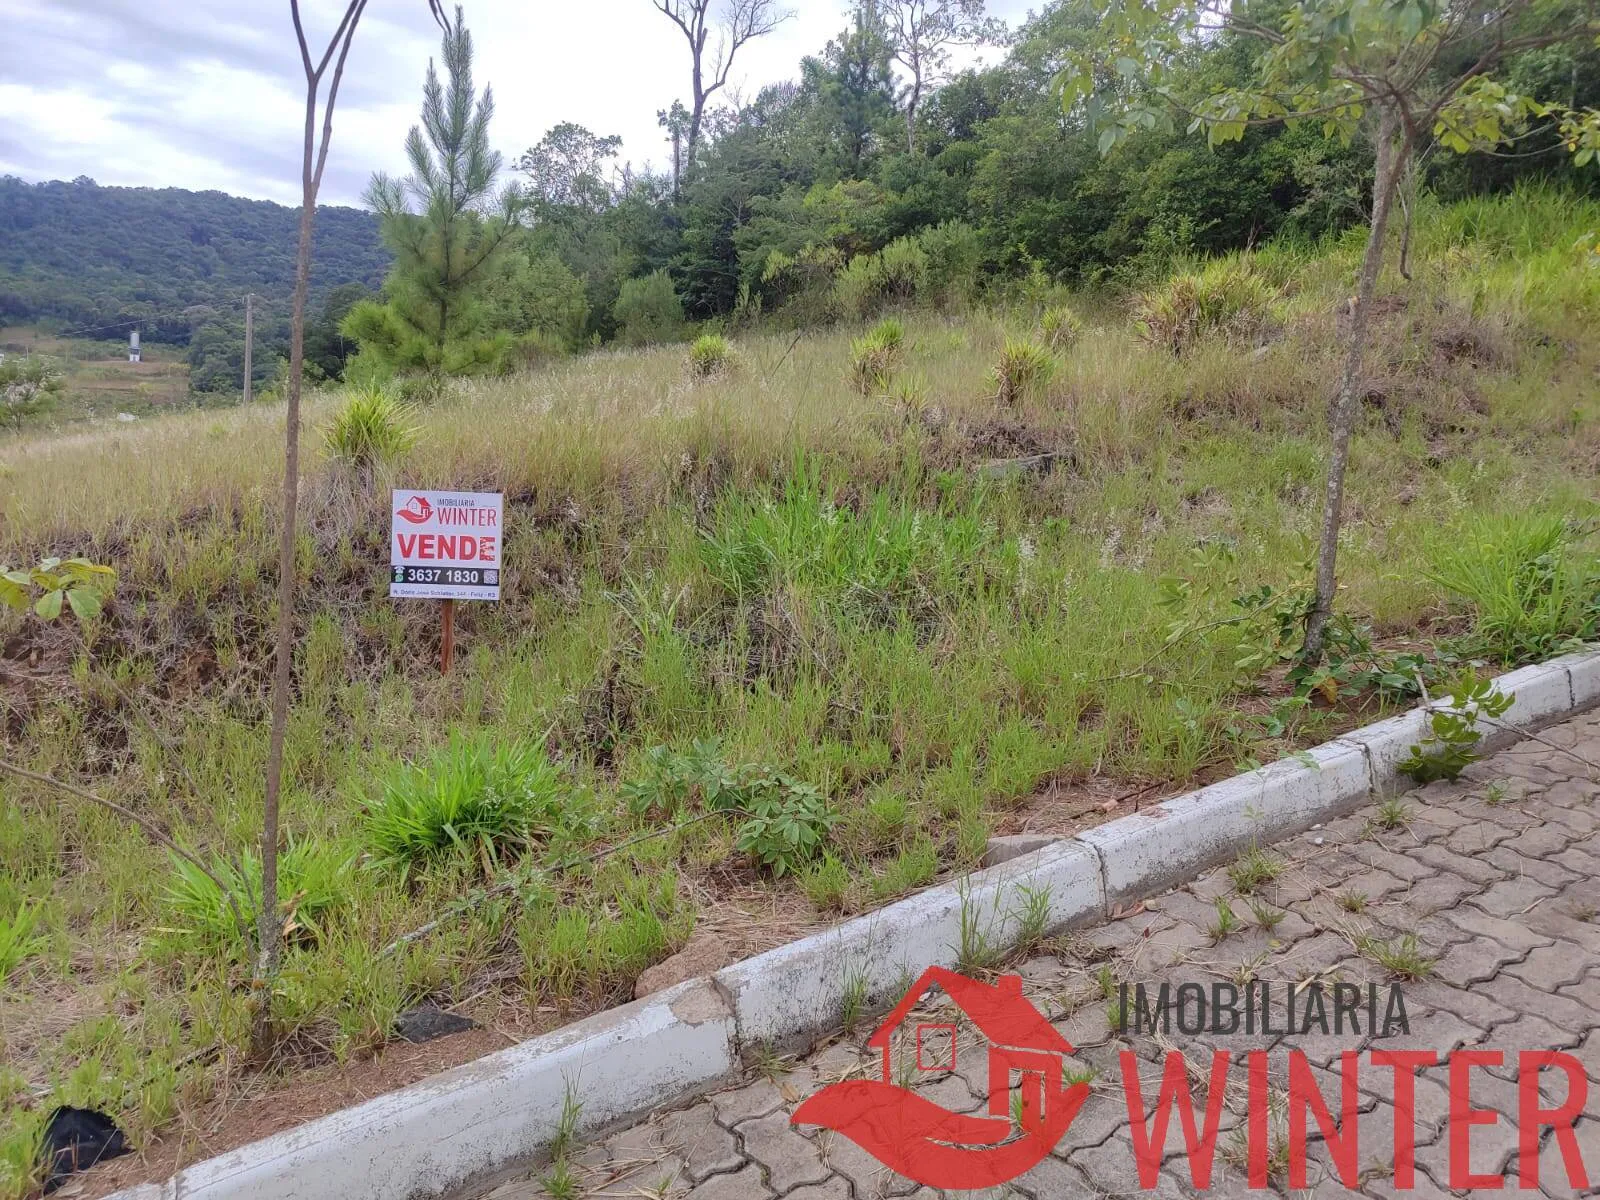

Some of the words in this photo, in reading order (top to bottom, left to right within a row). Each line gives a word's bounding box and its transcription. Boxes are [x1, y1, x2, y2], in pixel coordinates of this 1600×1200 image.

[437, 499, 475, 507] IMOBILIARIA
[437, 507, 497, 526] WINTER
[397, 534, 496, 562] VENDE
[408, 569, 441, 582] 3637
[446, 570, 479, 583] 1830
